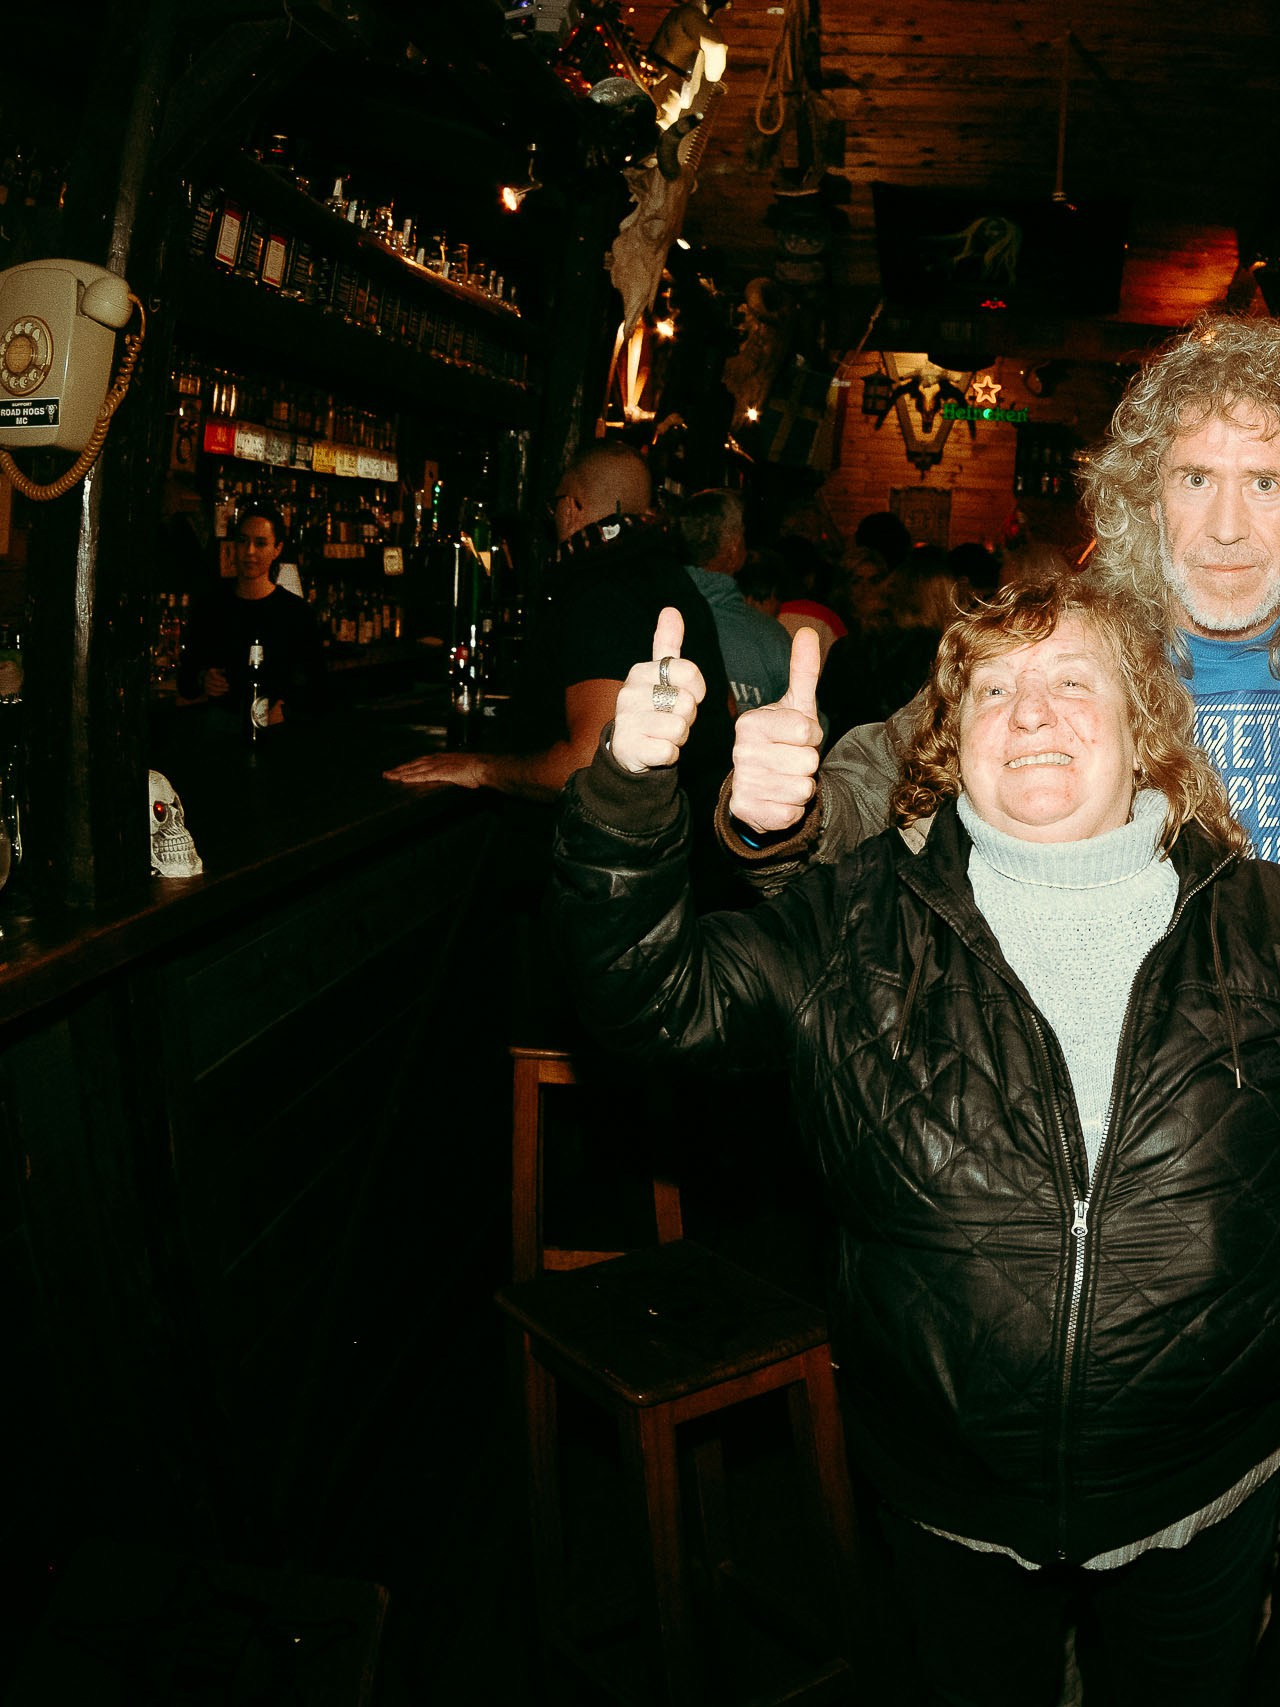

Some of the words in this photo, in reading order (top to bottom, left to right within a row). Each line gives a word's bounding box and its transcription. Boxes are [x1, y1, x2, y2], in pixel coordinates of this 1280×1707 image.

[1, 408, 21, 416] ROAD
[22, 407, 45, 416] HOGS
[943, 403, 1030, 422] Heineken
[16, 417, 28, 425] MC
